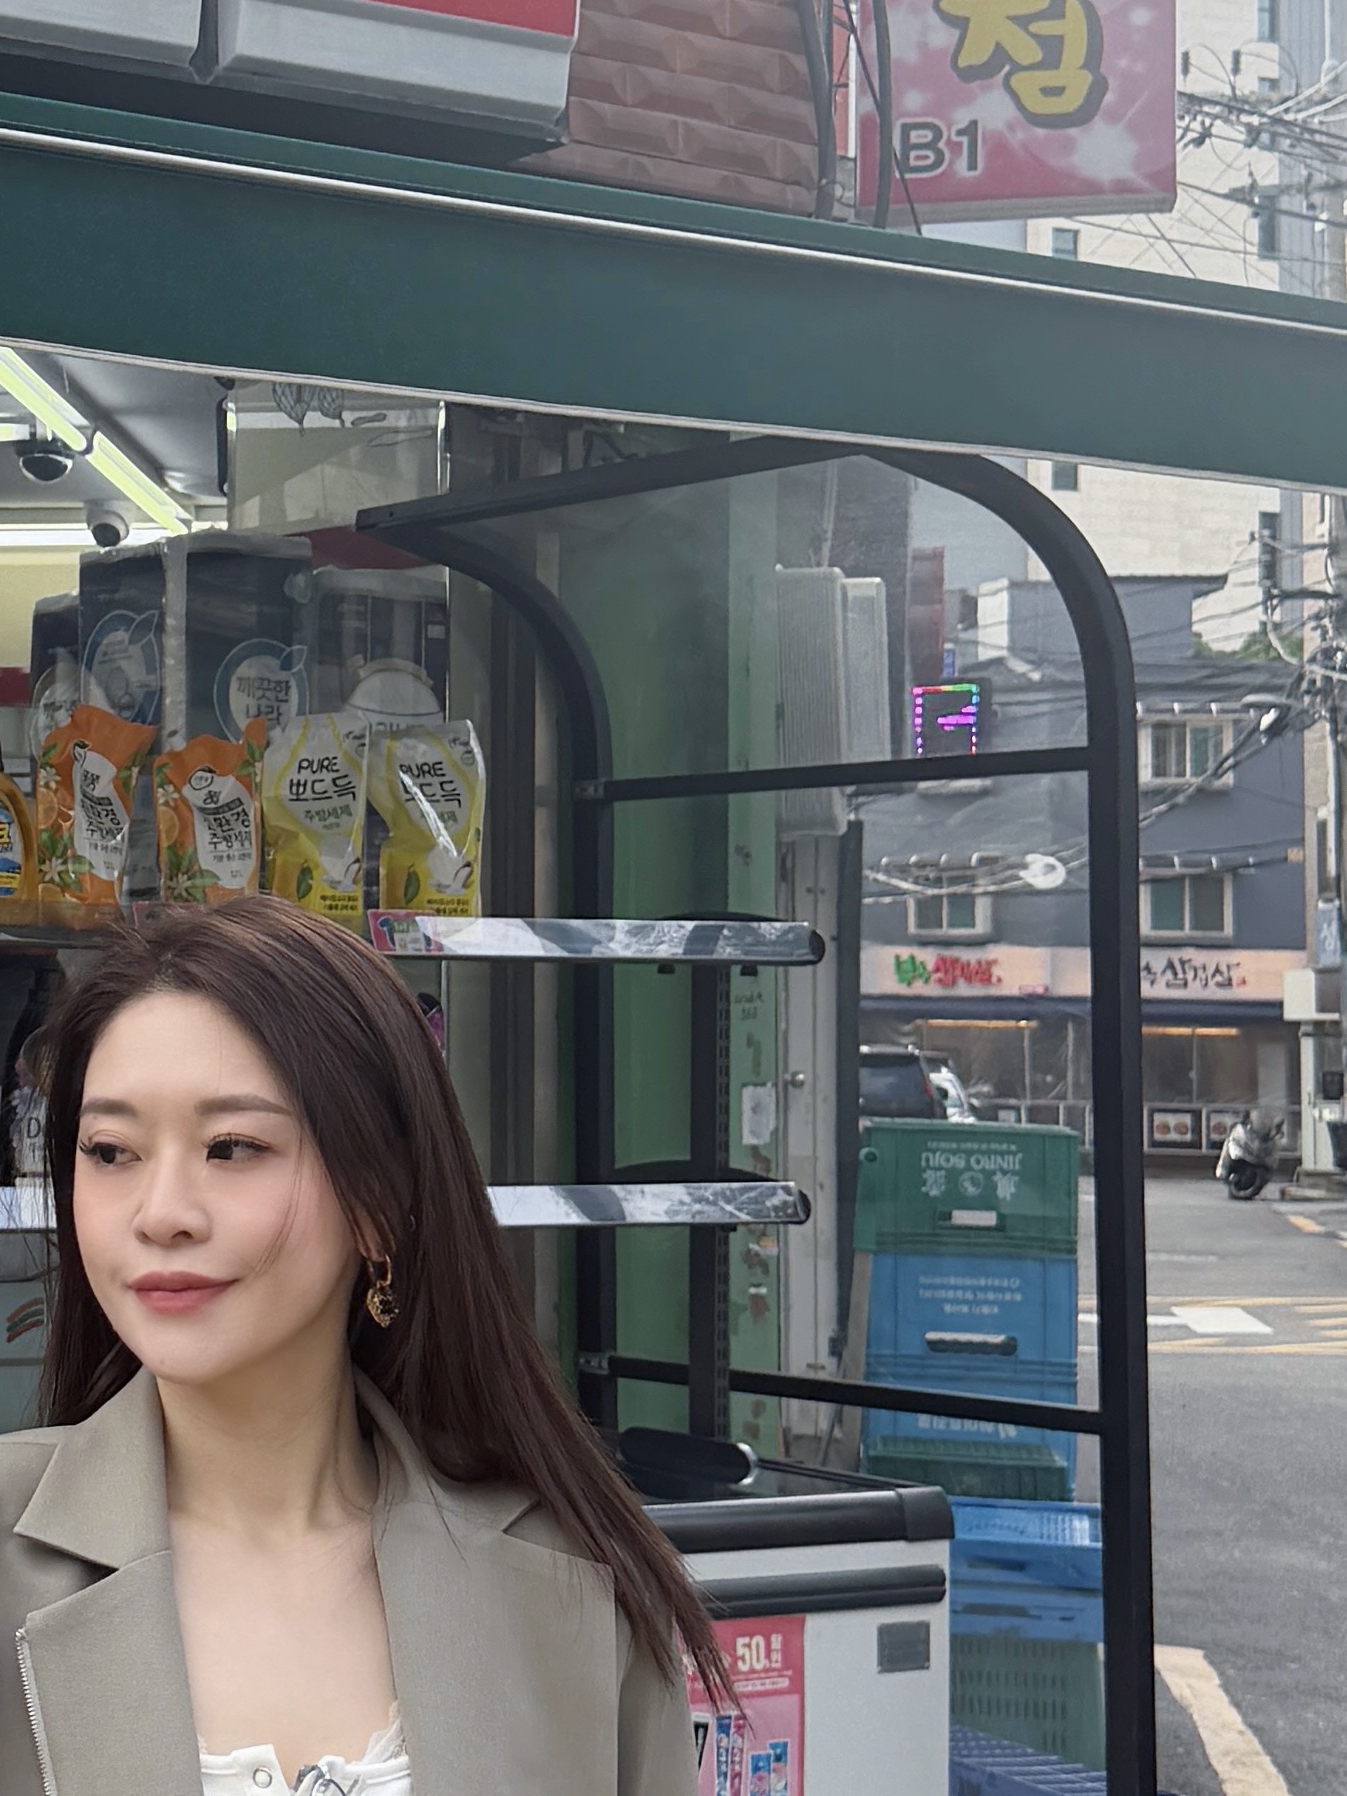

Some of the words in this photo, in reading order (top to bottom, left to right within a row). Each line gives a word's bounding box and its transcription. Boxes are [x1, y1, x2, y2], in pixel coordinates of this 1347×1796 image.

[901, 120, 981, 173] B1
[236, 679, 292, 706] 깨끗한
[298, 755, 340, 775] PURE
[399, 760, 448, 779] PURE
[287, 774, 358, 803] 뽀드득
[304, 804, 354, 822] 주방세제
[920, 1151, 969, 1170] SOJU
[970, 1152, 1023, 1172] JINRO
